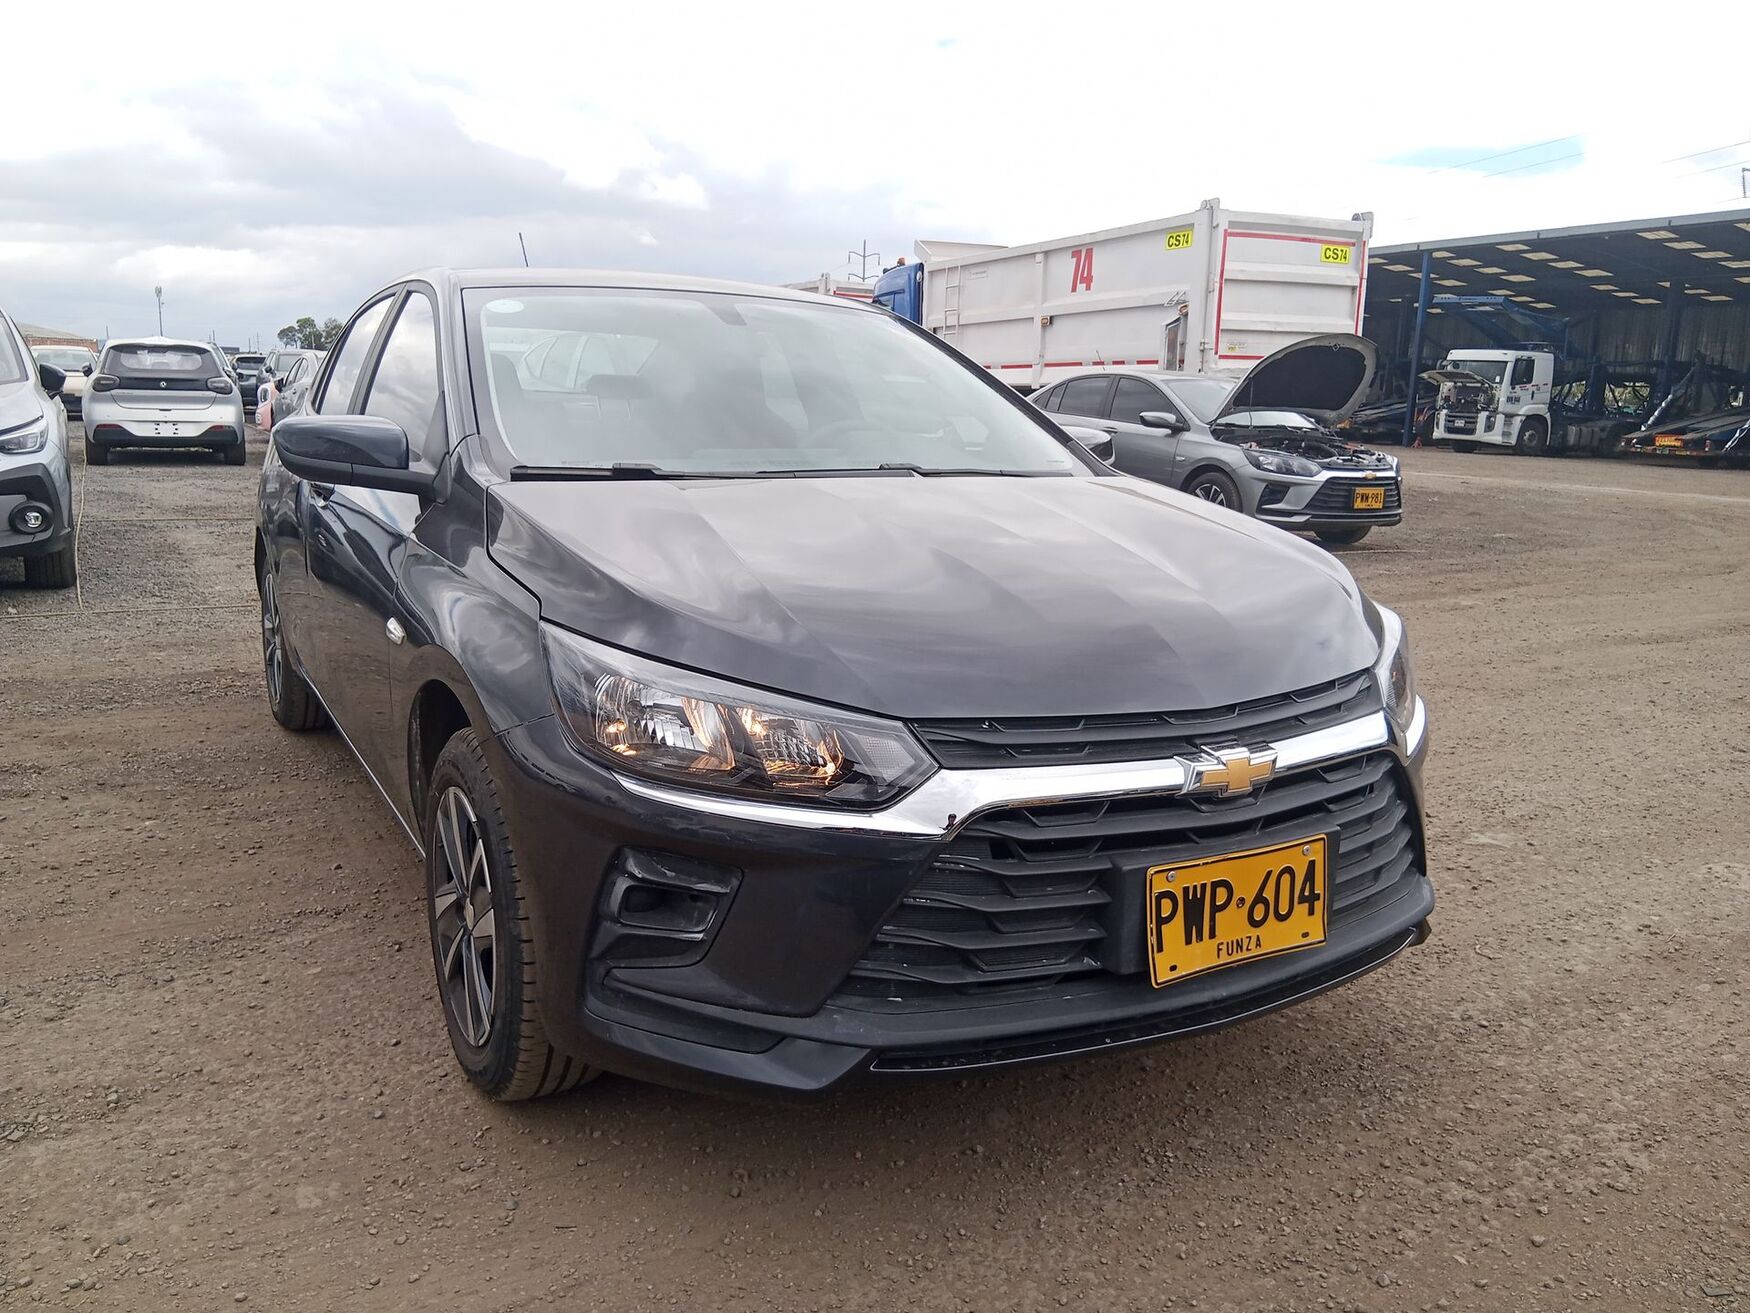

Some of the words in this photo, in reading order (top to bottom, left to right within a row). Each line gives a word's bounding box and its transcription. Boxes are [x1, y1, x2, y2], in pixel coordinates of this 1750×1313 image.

[1167, 232, 1189, 248] CS74
[1324, 247, 1347, 263] CS74
[1071, 247, 1094, 293] 74
[1216, 934, 1262, 959] FUNZA
